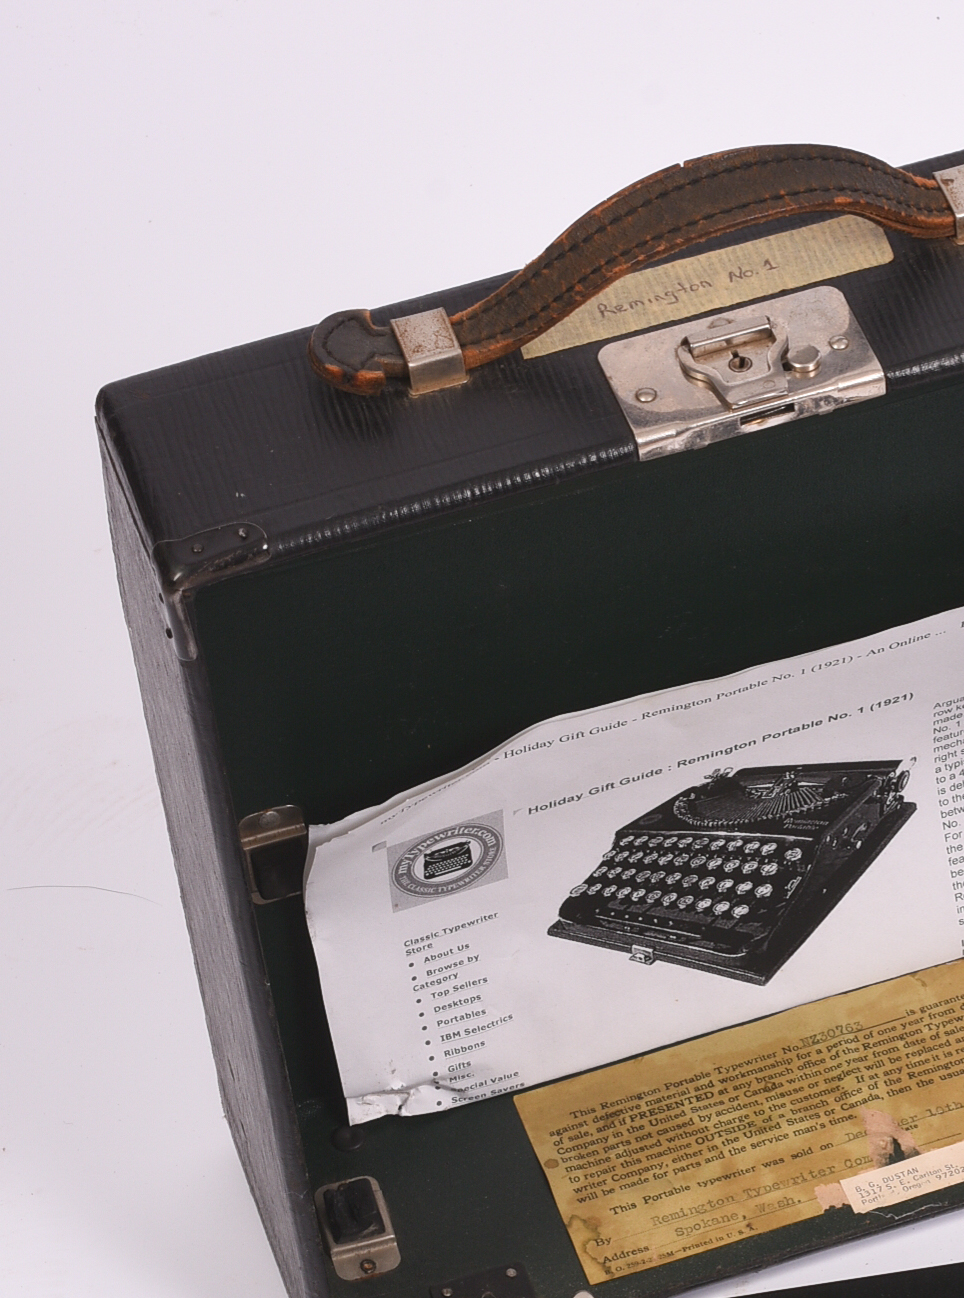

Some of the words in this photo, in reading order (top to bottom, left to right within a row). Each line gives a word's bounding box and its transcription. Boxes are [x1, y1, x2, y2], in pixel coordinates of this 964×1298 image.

[597, 280, 713, 318] Remington
[728, 266, 759, 282] No.
[763, 258, 779, 271] 1
[503, 740, 554, 759] Holiday
[559, 731, 585, 743] Gift
[589, 720, 628, 735] Guide
[641, 696, 712, 720] Remington
[716, 679, 769, 701] Portable
[771, 673, 795, 682] No.
[811, 655, 853, 673] (1921)
[865, 646, 885, 657] An
[888, 631, 931, 650] Online
[933, 707, 953, 717] row
[528, 792, 584, 815] Holiday
[588, 782, 616, 795] Gift
[619, 768, 663, 786] Guide
[676, 739, 757, 769] Remington
[761, 719, 823, 742] Portable
[827, 712, 852, 723] No.
[857, 706, 865, 714] 1
[870, 692, 914, 712] (1921)
[934, 750, 957, 763] right
[944, 831, 962, 842] For
[404, 931, 439, 947] Classic
[442, 912, 499, 935] Typewriter
[405, 942, 434, 956] Store
[424, 949, 454, 963] About
[457, 943, 470, 952] Us
[426, 959, 464, 976] Browse
[467, 954, 480, 963] by
[412, 972, 459, 992] Category
[431, 988, 450, 999] Top
[453, 976, 488, 992] Sellers
[434, 994, 482, 1013] Desktops
[437, 1008, 487, 1027] Portables
[440, 1031, 461, 1042] IBM
[464, 1013, 514, 1033] Selectrics
[444, 1040, 486, 1057] Ribbons
[448, 1060, 472, 1072] Gifts
[450, 1072, 475, 1083] Misc.
[451, 1078, 488, 1093] pecial
[490, 1071, 520, 1084] Value
[553, 1135, 564, 1147] of
[568, 1130, 593, 1143] sale,
[597, 1121, 617, 1135] and
[618, 1118, 627, 1127] if
[629, 1092, 715, 1123] PRESENTED
[718, 1087, 729, 1096] at
[733, 1079, 753, 1092] any
[757, 1068, 794, 1084] branch
[796, 1057, 827, 1071] office
[830, 1051, 841, 1060] of
[842, 1046, 860, 1055] the
[862, 1030, 923, 1051] Remington
[570, 1107, 596, 1119] This
[600, 1087, 661, 1110] Remington
[664, 1072, 712, 1090] Portable
[714, 1050, 778, 1074] Typewriter
[782, 1045, 801, 1054] No.
[451, 1092, 487, 1103] Screen
[491, 1082, 525, 1096] Savers
[609, 1202, 637, 1216] This
[642, 1185, 691, 1205] Portable
[697, 1165, 757, 1189] typewriter
[761, 1157, 785, 1168] was
[791, 1147, 815, 1161] sold
[820, 1142, 834, 1150] on
[859, 1186, 882, 1198] 1317
[913, 1168, 942, 1181] Carlton
[882, 1167, 919, 1184] DUSTAN
[595, 1237, 612, 1247] By
[651, 1195, 735, 1227] Remington
[603, 1245, 649, 1264] Address
[674, 1212, 747, 1237] Spokane,
[755, 1196, 801, 1214] Wash.
